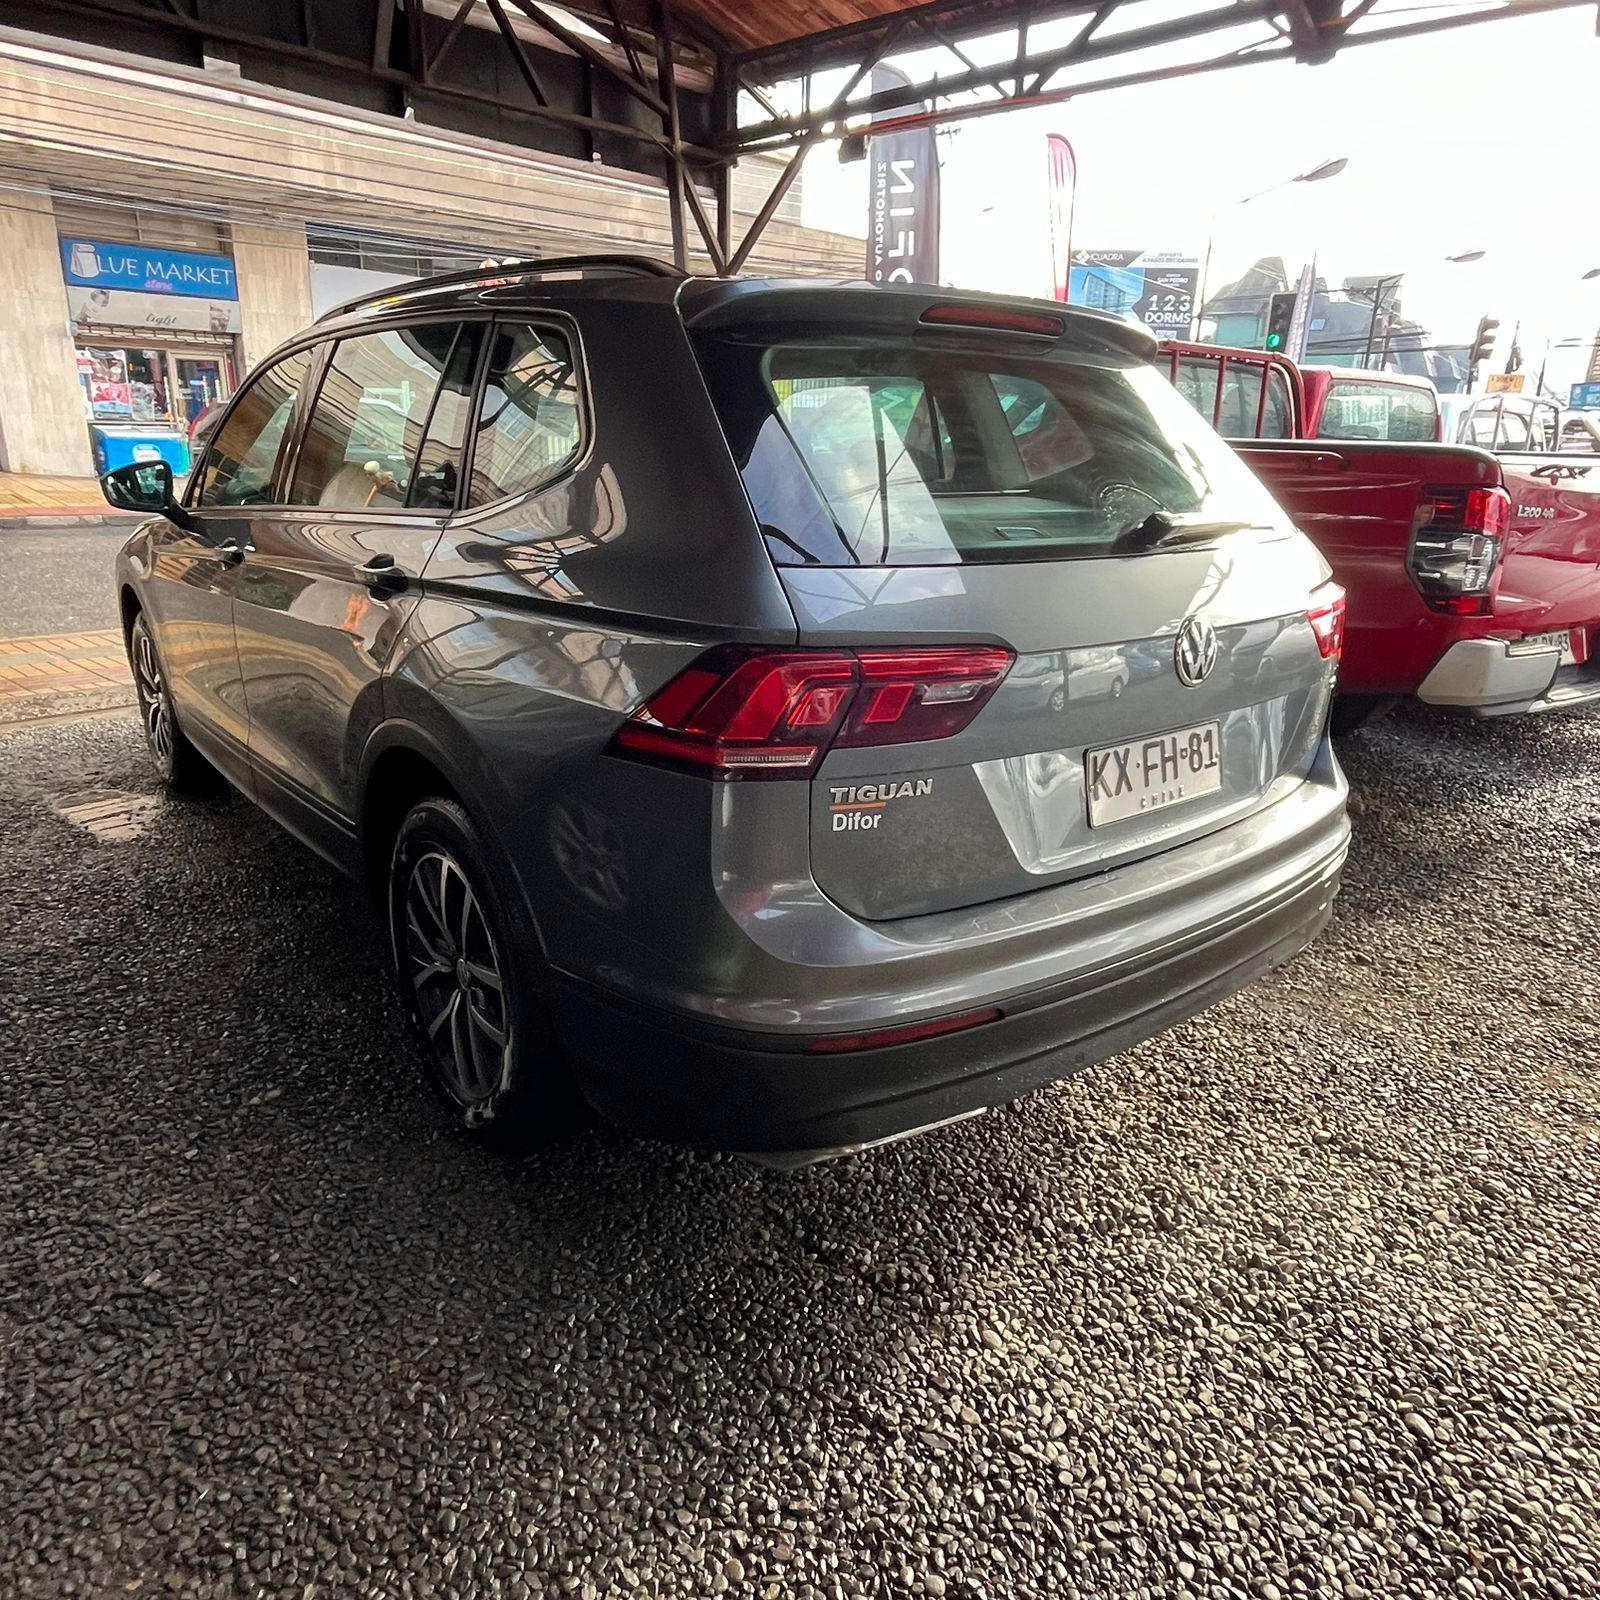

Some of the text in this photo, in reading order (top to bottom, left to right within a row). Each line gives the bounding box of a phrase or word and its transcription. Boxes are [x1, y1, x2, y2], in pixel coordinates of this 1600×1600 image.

[145, 259, 234, 286] MARKET
[1144, 311, 1192, 324] DORMS
[1517, 504, 1542, 518] L200
[829, 778, 933, 804] TIGUAN
[832, 811, 882, 832] Difor
